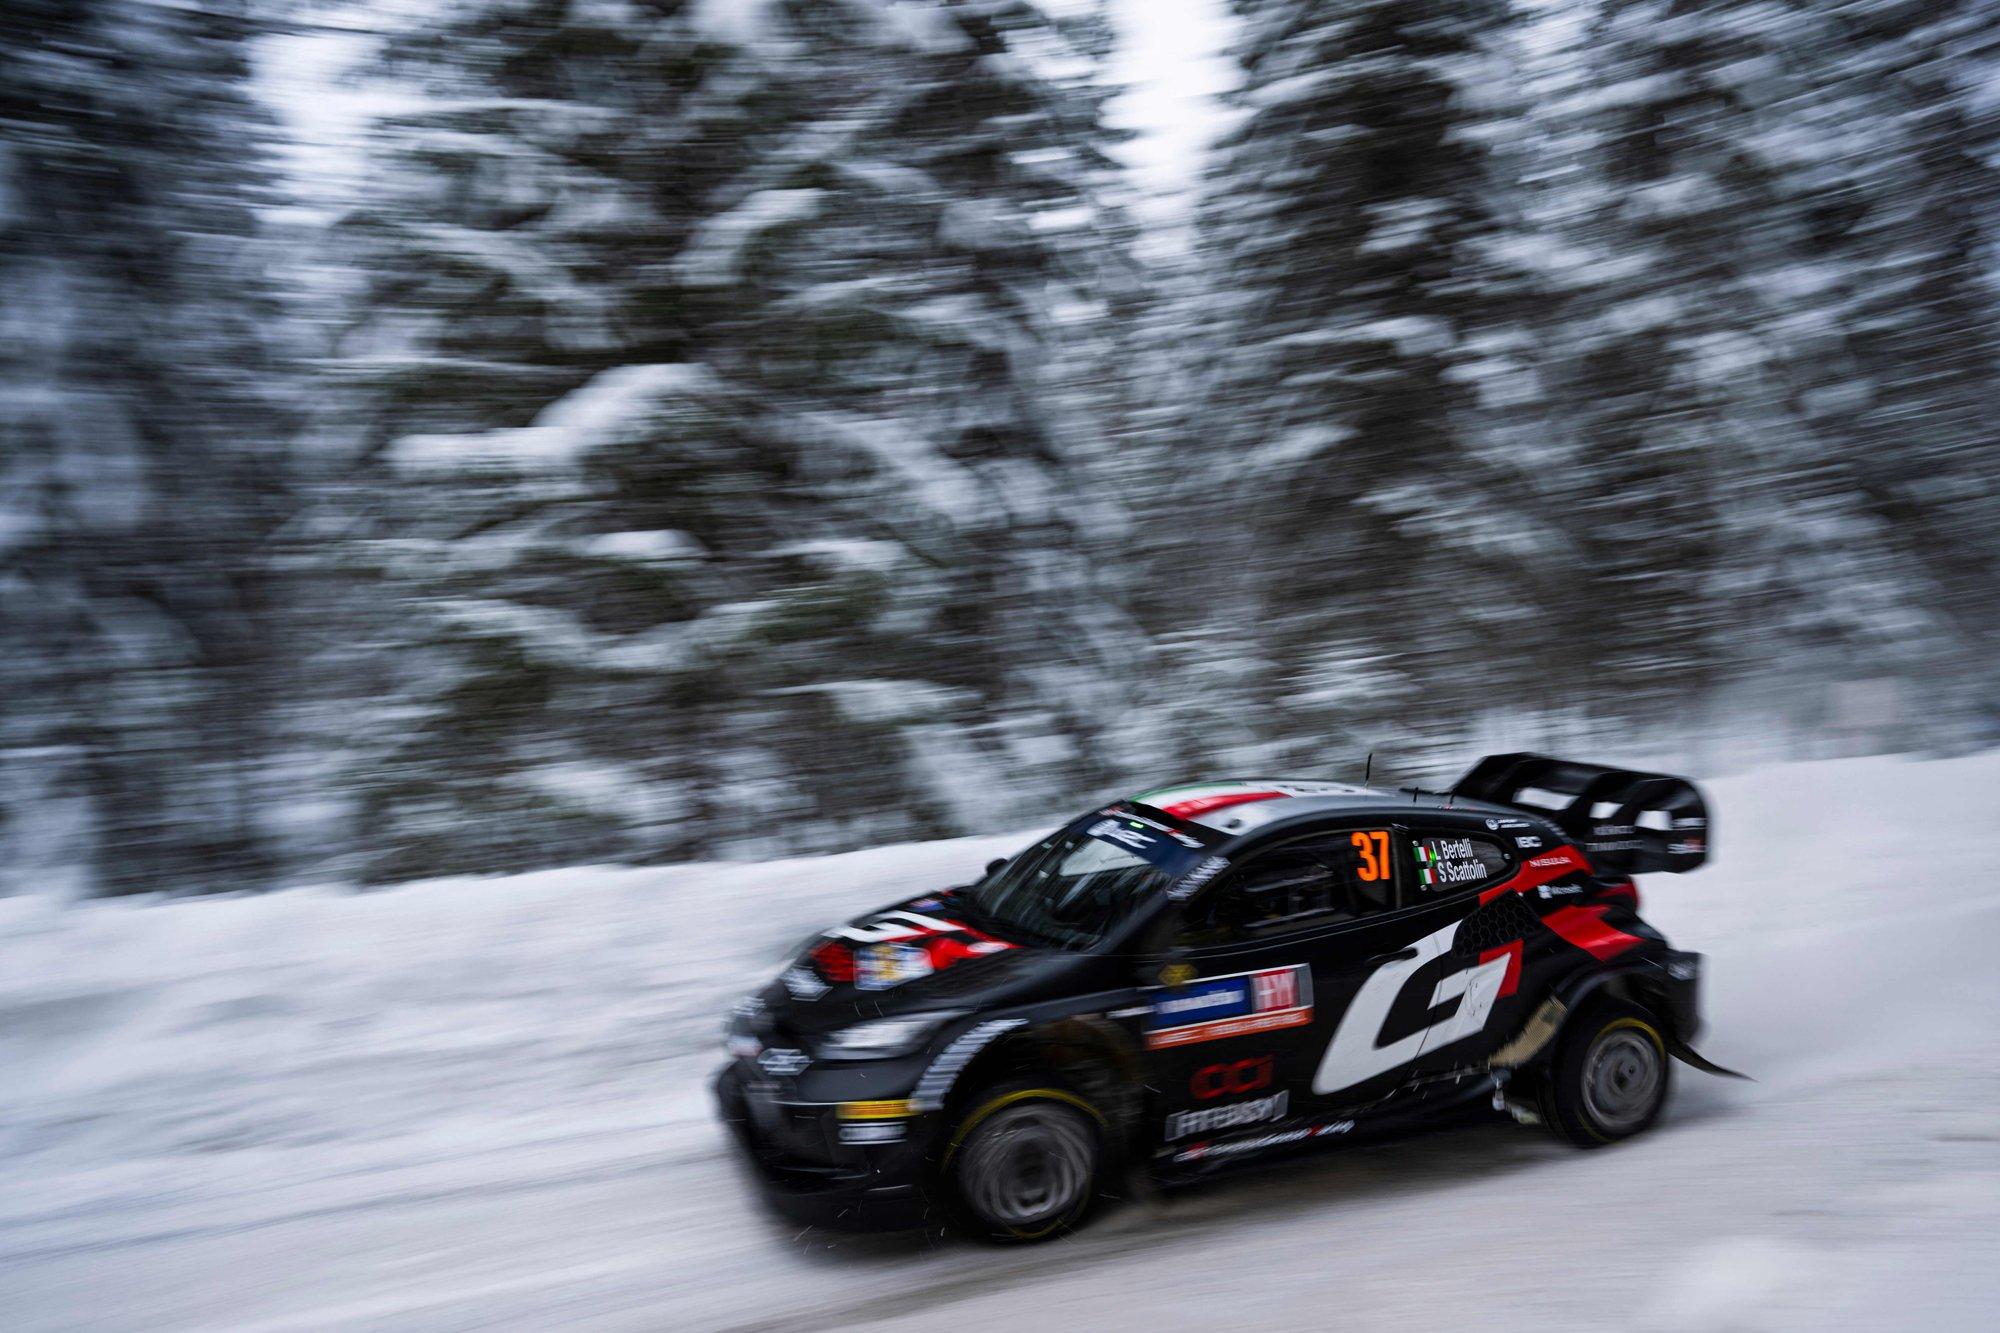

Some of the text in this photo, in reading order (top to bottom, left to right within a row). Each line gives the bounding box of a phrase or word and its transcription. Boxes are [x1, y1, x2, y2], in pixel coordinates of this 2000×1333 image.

[1351, 831, 1391, 882] 37
[1431, 838, 1473, 860] L Bertelli
[1437, 859, 1488, 882] S Scattolin
